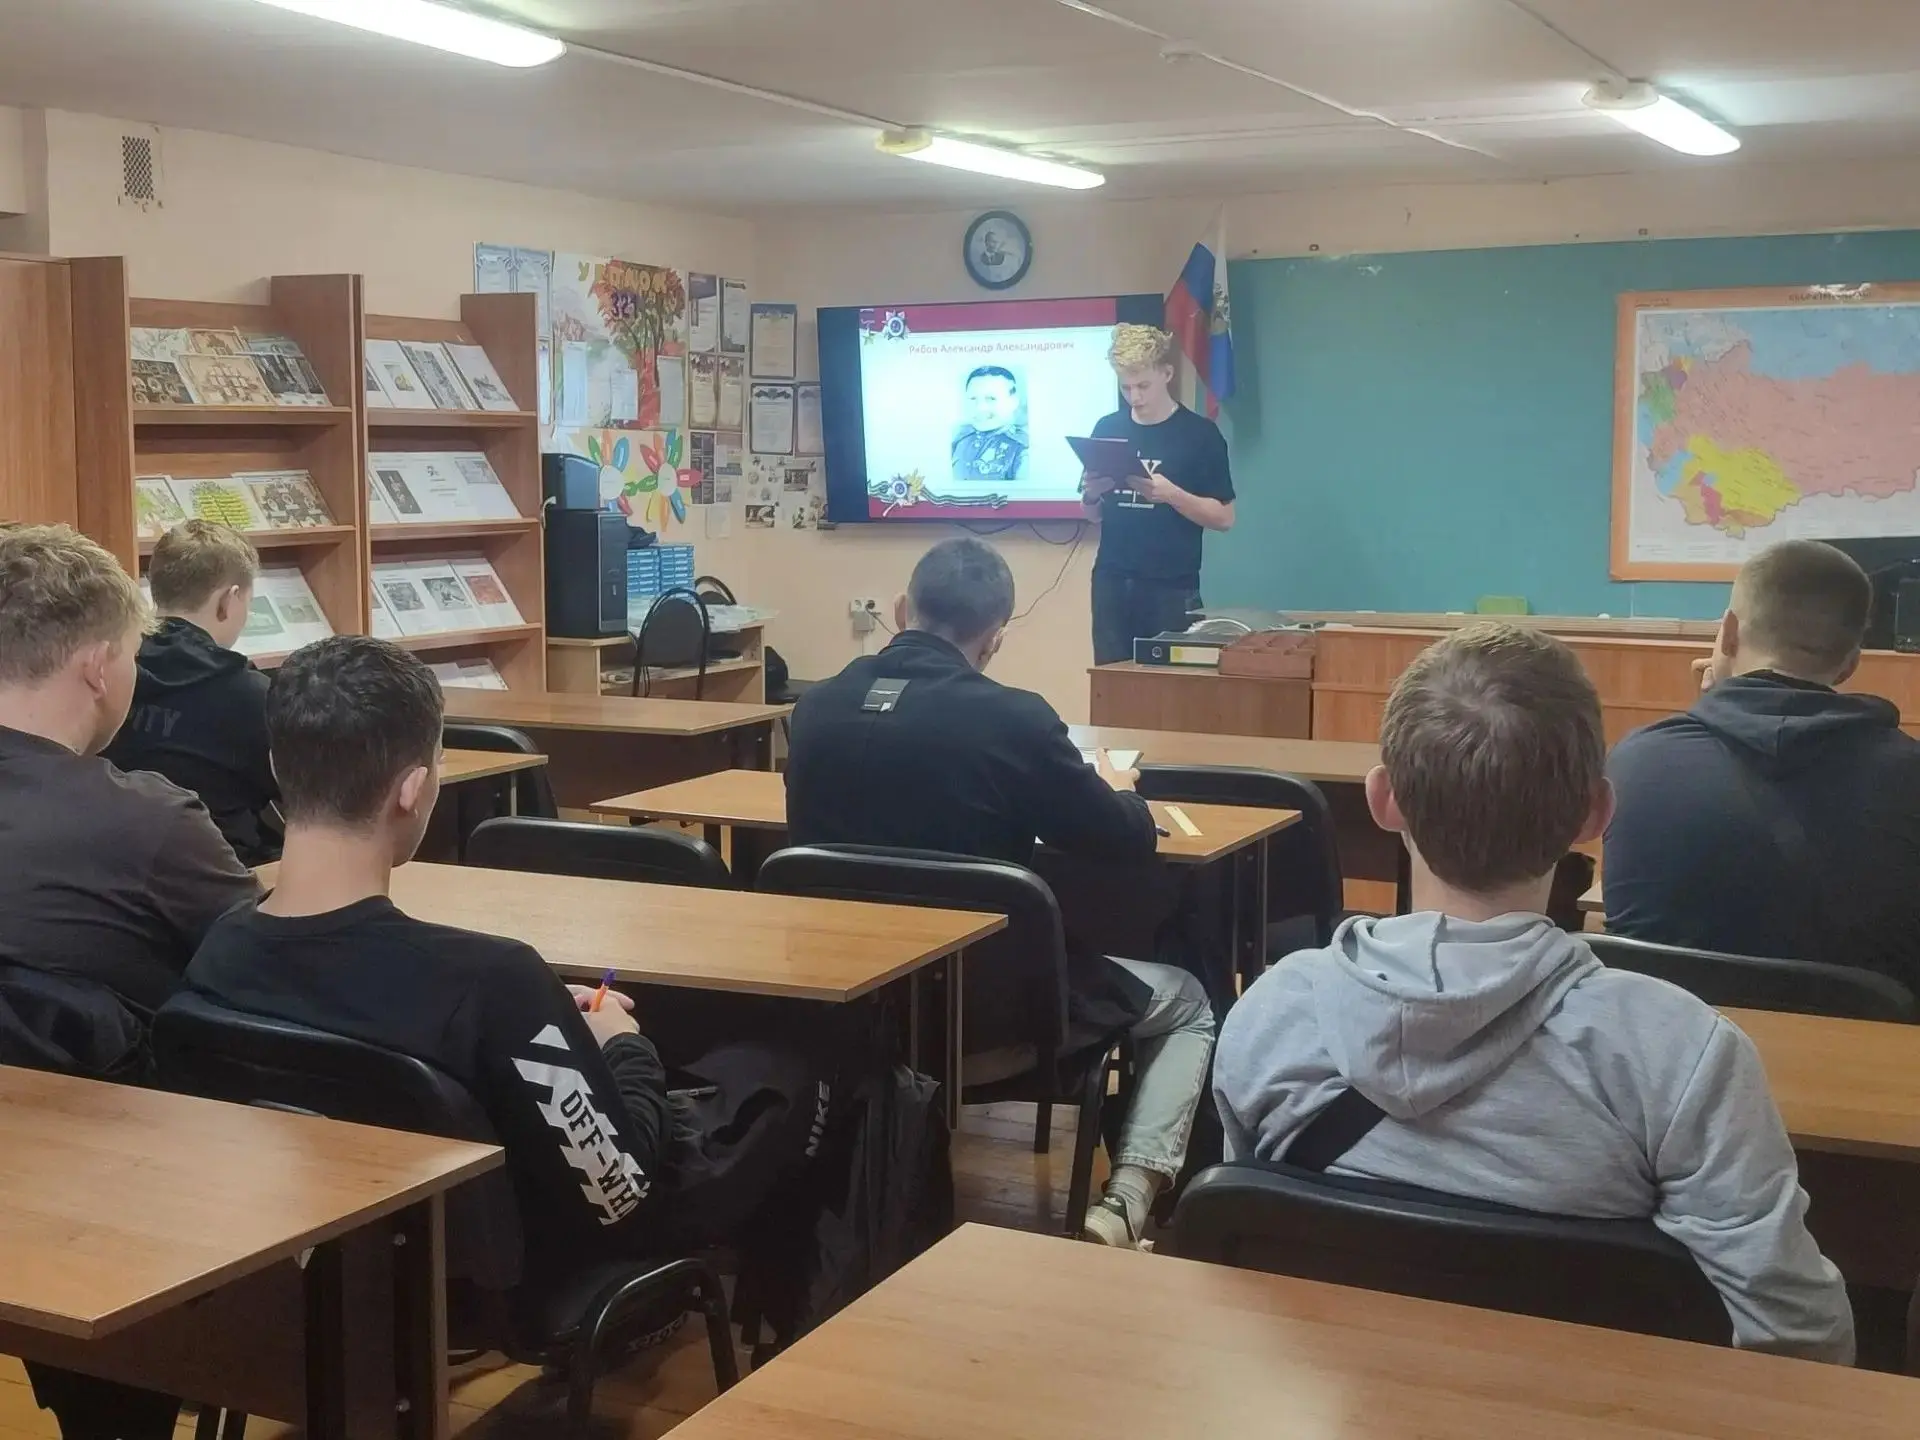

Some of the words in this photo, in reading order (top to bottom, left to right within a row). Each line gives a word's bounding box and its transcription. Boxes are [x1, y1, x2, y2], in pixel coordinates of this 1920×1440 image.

[909, 342, 938, 355] Рябов
[940, 343, 993, 354] Александр
[996, 341, 1075, 353] Александрович
[560, 1089, 640, 1218] OFF-WH
